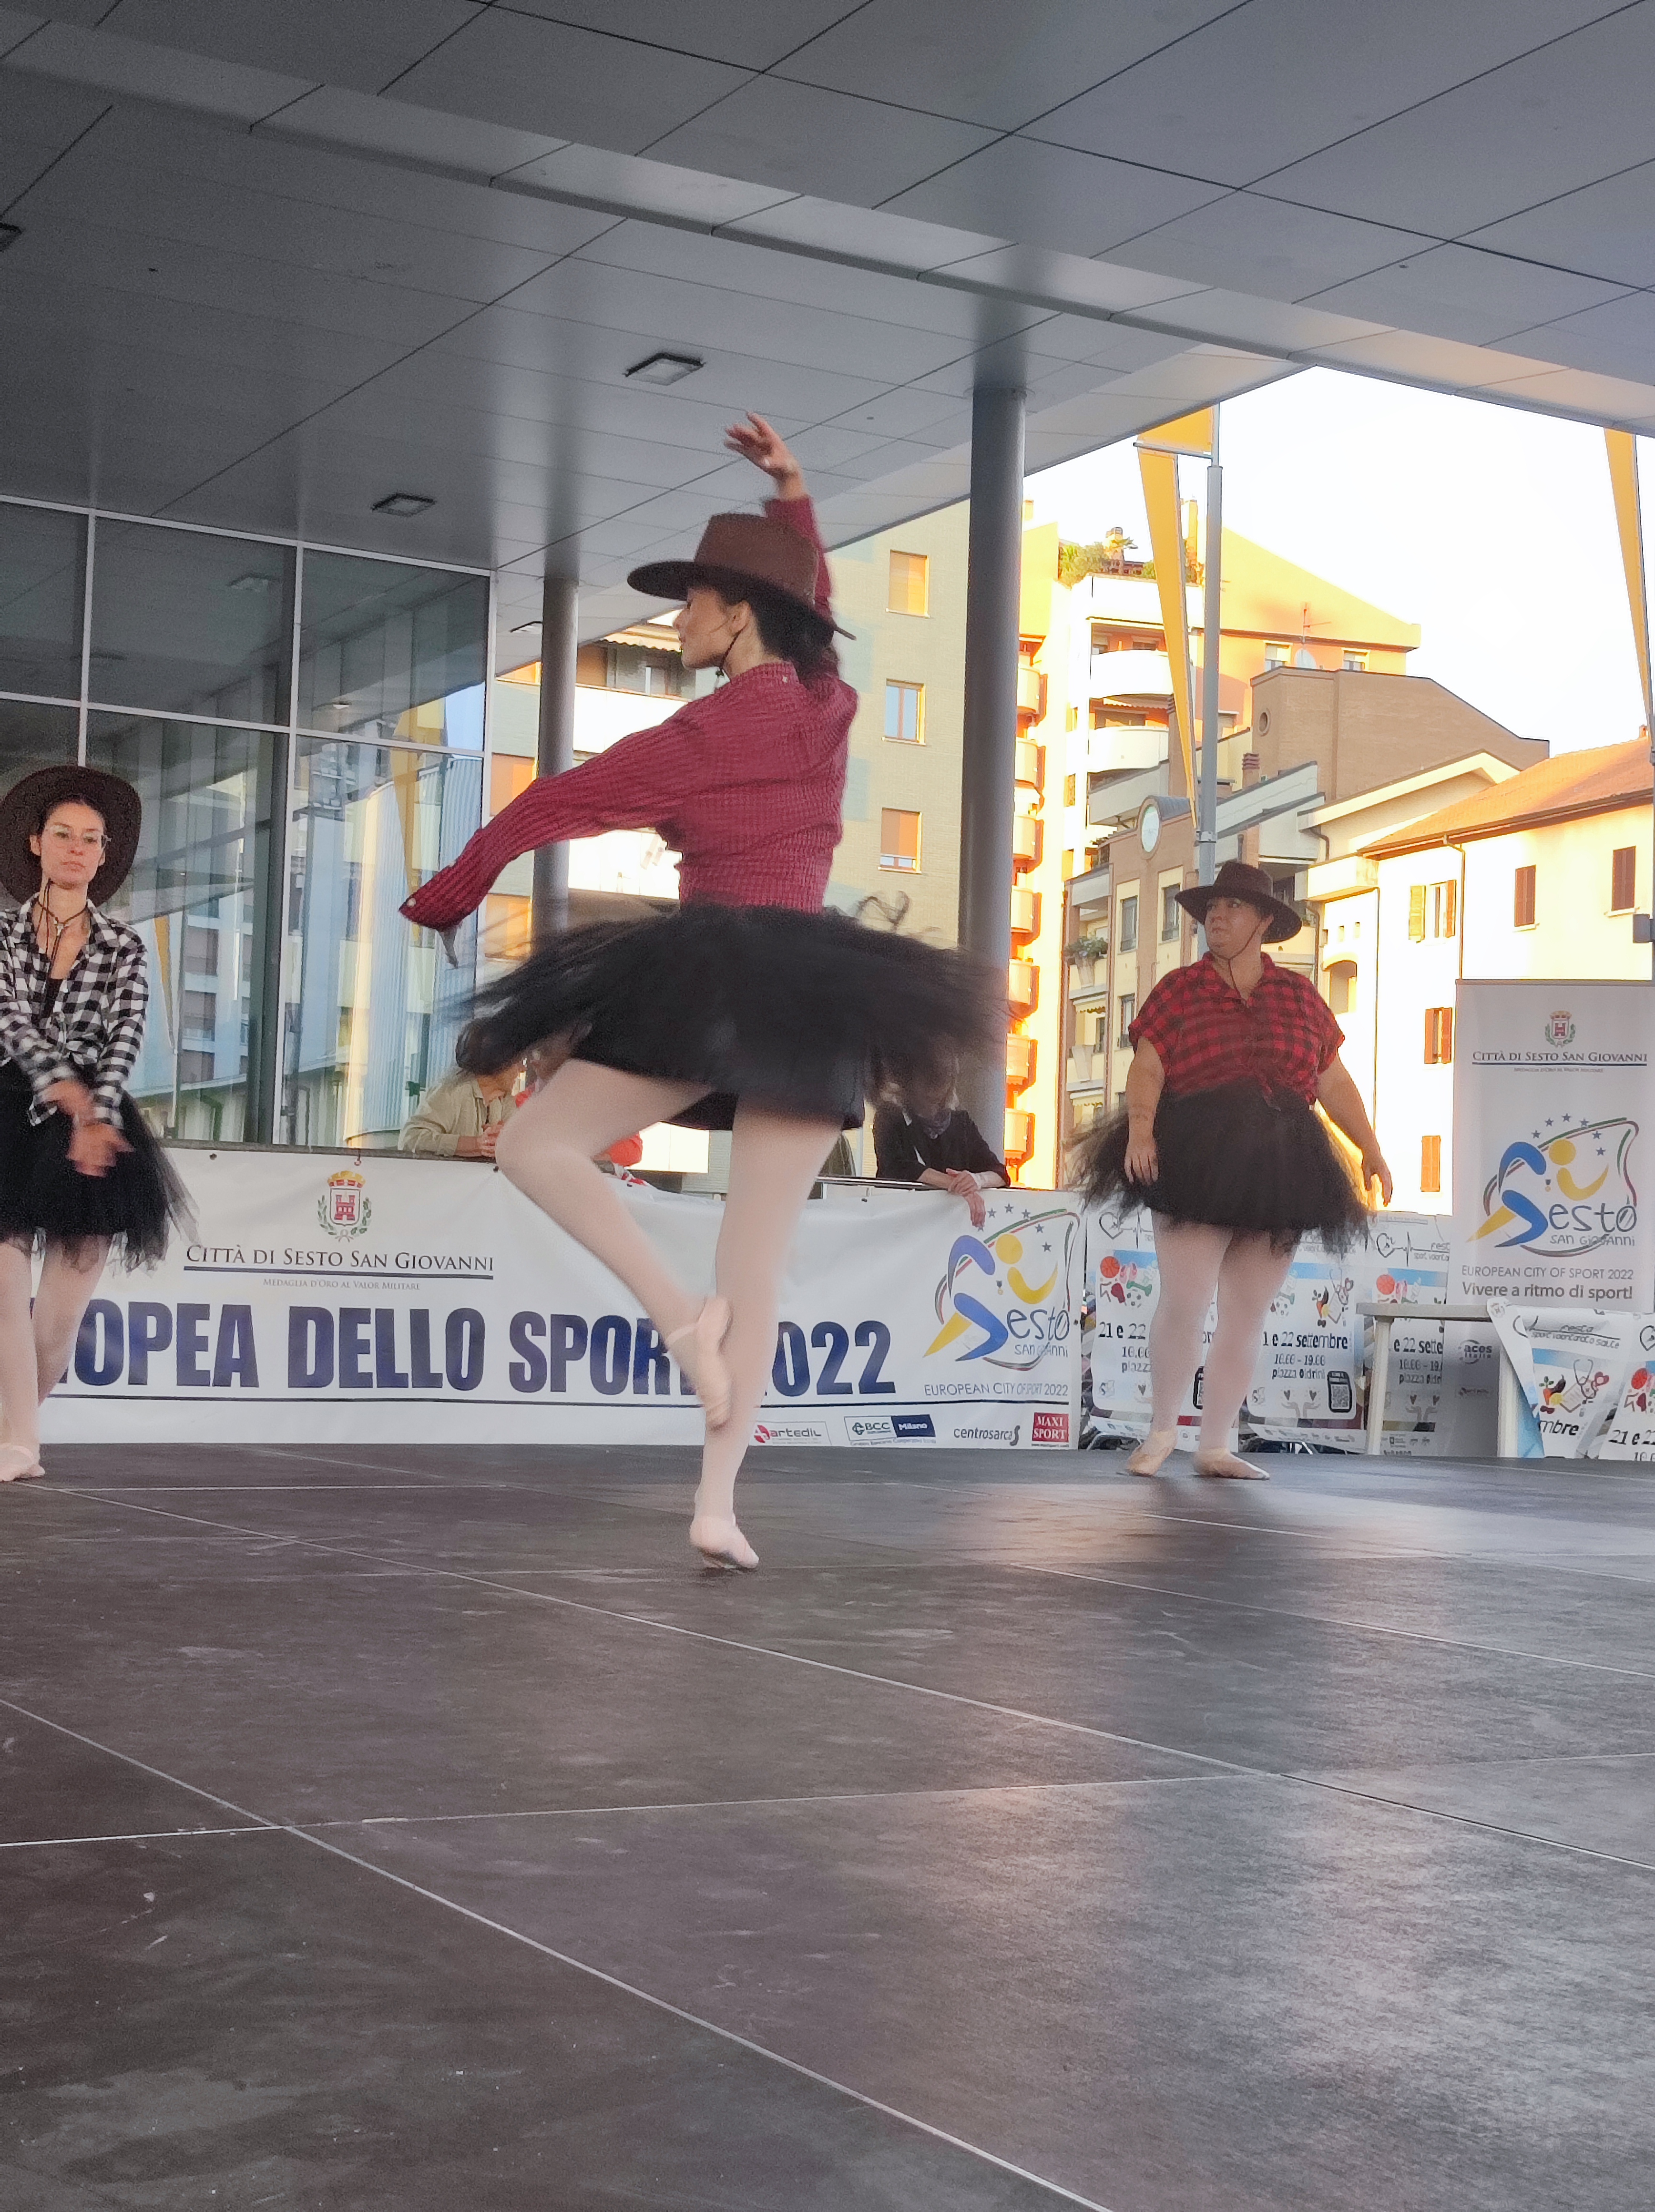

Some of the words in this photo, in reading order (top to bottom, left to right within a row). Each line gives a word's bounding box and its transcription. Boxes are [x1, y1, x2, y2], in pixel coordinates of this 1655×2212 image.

[1472, 1050, 1505, 1061] CITTÀ
[1509, 1052, 1521, 1061] DI
[1525, 1051, 1559, 1061] SESTO
[1562, 1051, 1584, 1061] SAN
[1588, 1052, 1647, 1062] GIOVANNI
[186, 1244, 246, 1264] CITTÀ
[253, 1249, 276, 1265] DI
[283, 1248, 343, 1267] SESTO
[350, 1250, 388, 1268] SAN
[395, 1251, 494, 1271] GIOVANNI
[1461, 1264, 1521, 1278] EUROPEAN
[1523, 1266, 1547, 1278] CITY
[1550, 1267, 1565, 1278] OF
[1568, 1267, 1605, 1280] SPORT
[1607, 1269, 1634, 1280] 2022
[263, 1278, 308, 1288] MEDAGLIA
[310, 1279, 338, 1289] D'ORO
[353, 1280, 379, 1290] VALOR
[1461, 1281, 1508, 1296] Vivere
[1511, 1286, 1520, 1297] a
[1524, 1284, 1565, 1298] ritmo
[1568, 1285, 1584, 1299] di
[1588, 1286, 1633, 1302] sport!
[1097, 1321, 1113, 1338] 21
[1116, 1325, 1124, 1339] e
[1127, 1323, 1146, 1340] 22
[57, 1298, 259, 1388] OPEA
[287, 1305, 485, 1391] DELLO
[765, 1320, 896, 1397] 022
[1272, 1333, 1278, 1347] e
[1280, 1331, 1294, 1347] 22
[1295, 1332, 1348, 1350] settembre
[1393, 1338, 1400, 1352] e
[1402, 1337, 1416, 1353] 22
[1418, 1338, 1443, 1354] sette
[1122, 1360, 1152, 1373] piazz
[924, 1383, 990, 1396] EUROPEAN
[993, 1382, 1015, 1394] CITY
[1044, 1383, 1069, 1396] 2022
[865, 1422, 890, 1431] BCC
[899, 1423, 928, 1431] Milano
[1037, 1415, 1063, 1427] MAXI
[1538, 1419, 1579, 1436] mbre
[1033, 1428, 1066, 1440] SPORT
[1608, 1429, 1628, 1445] 21
[1632, 1433, 1640, 1445] e
